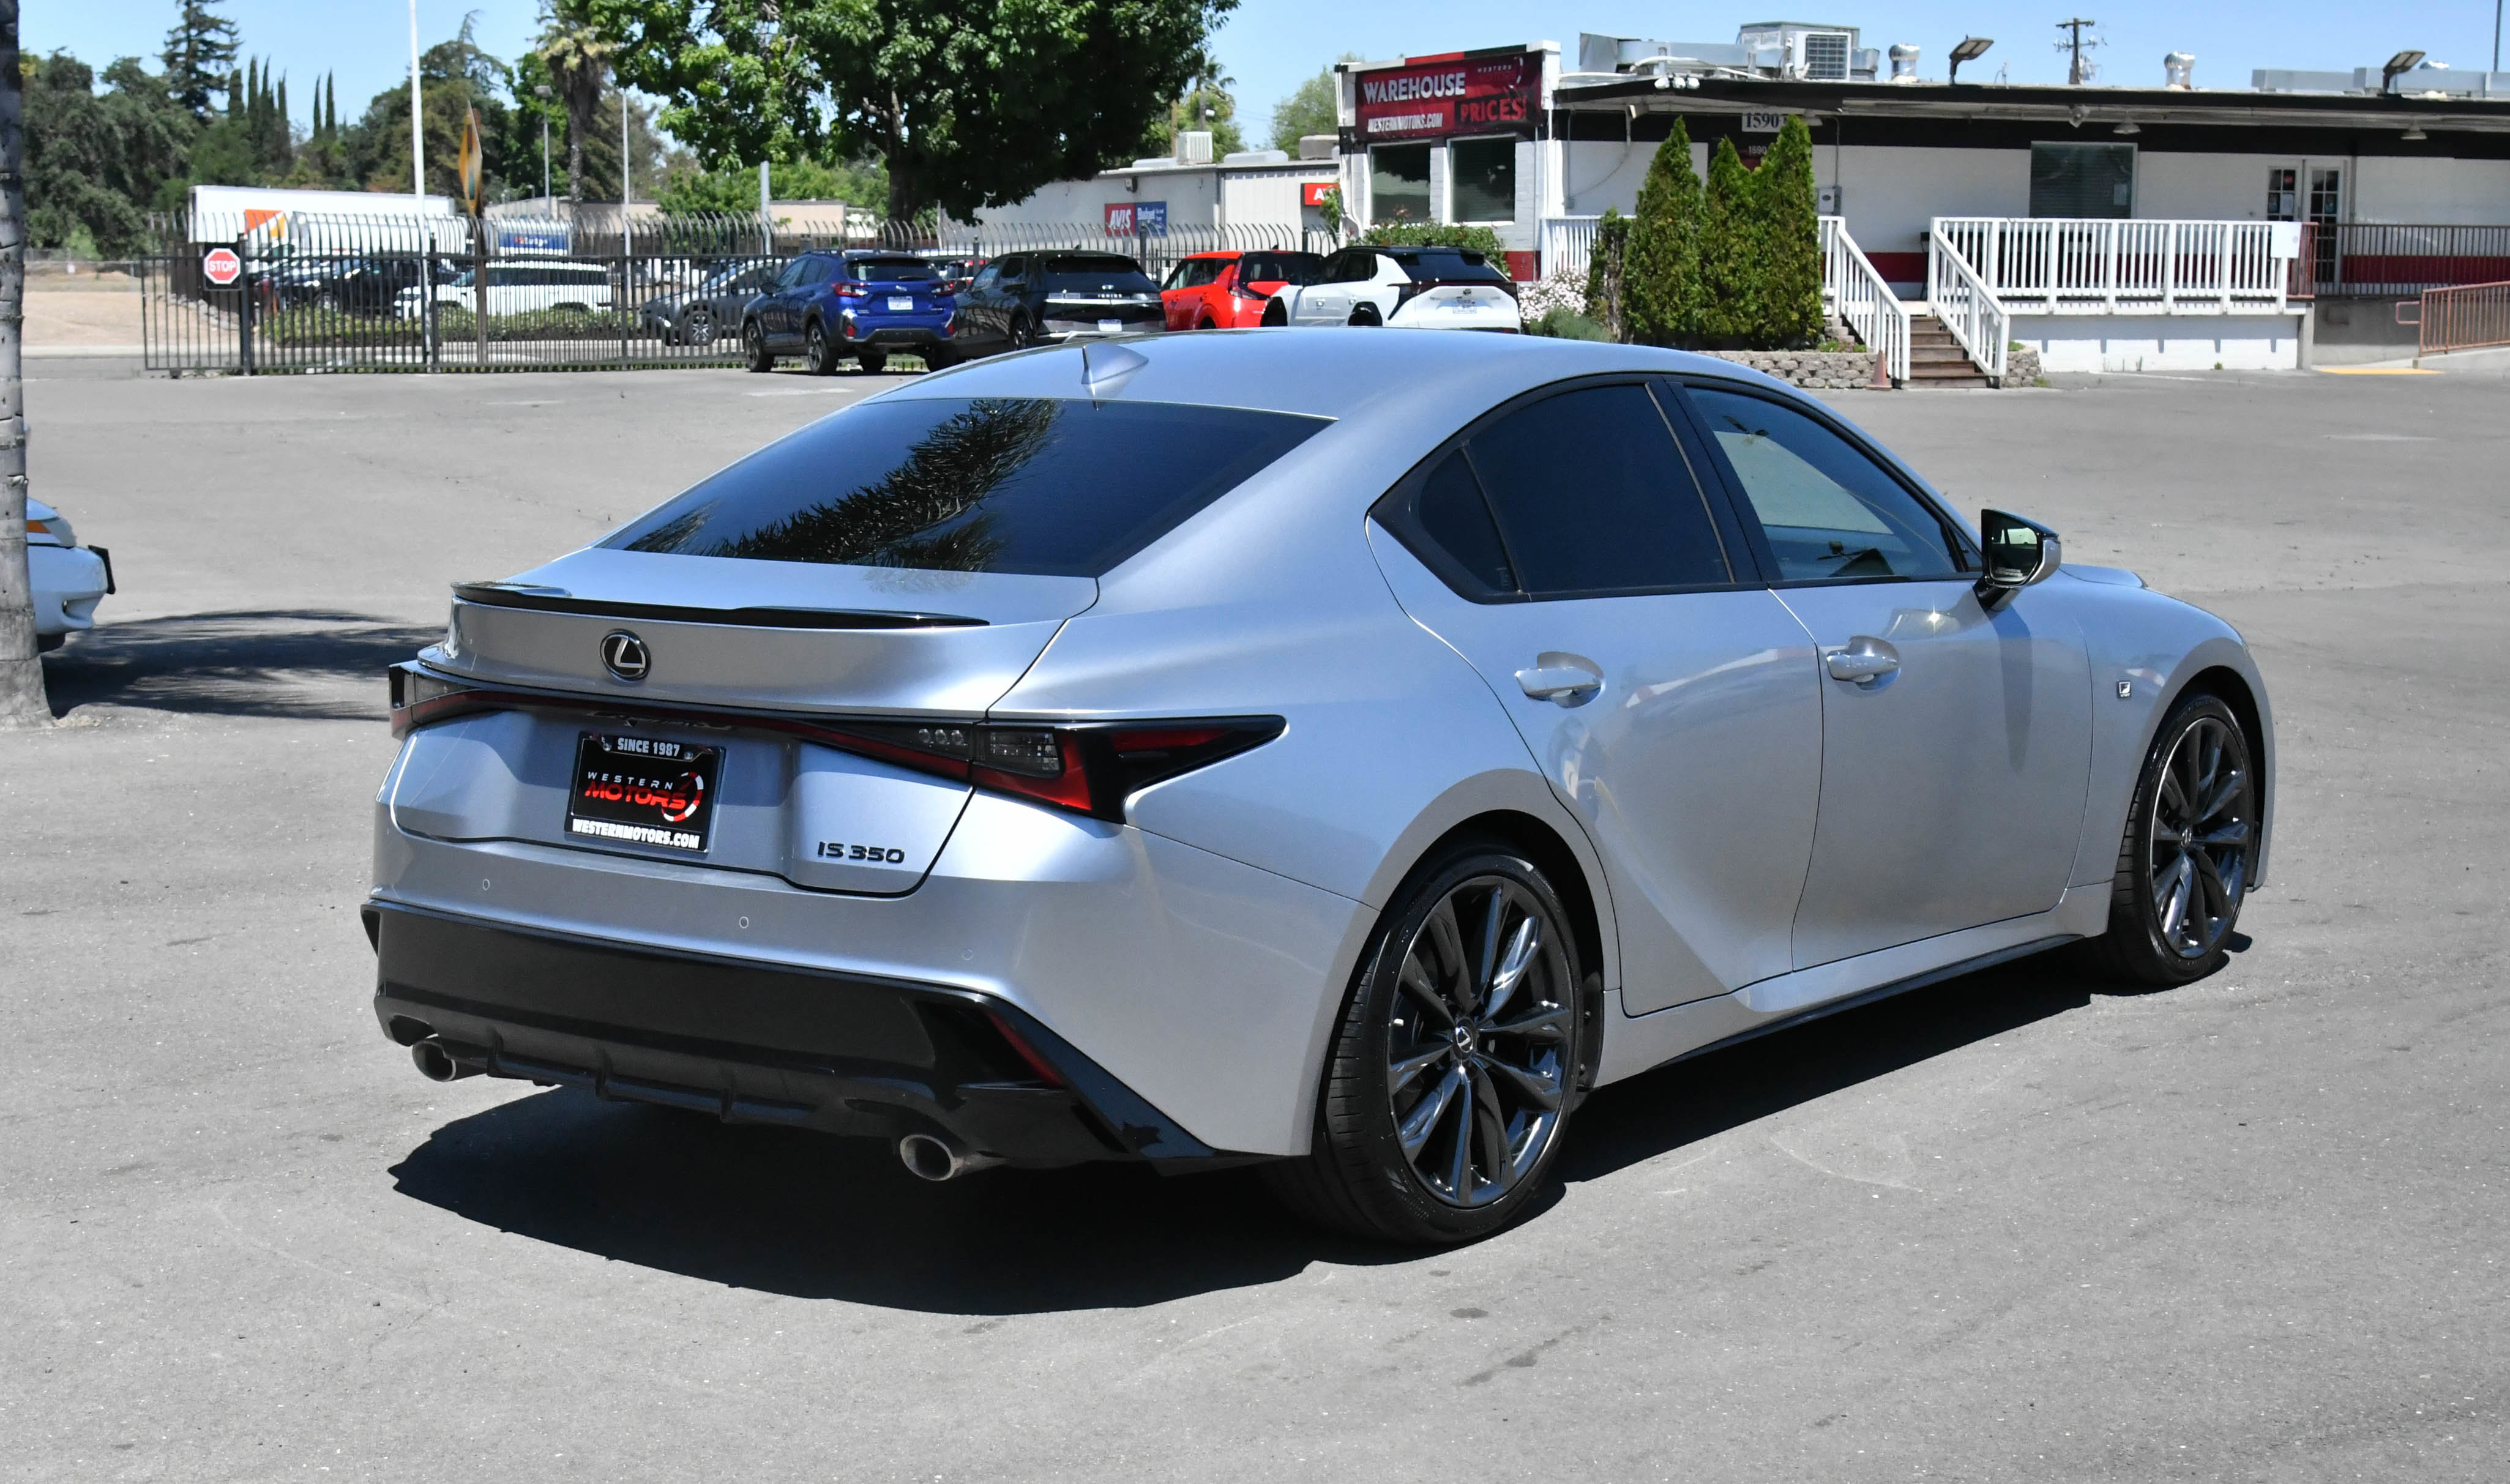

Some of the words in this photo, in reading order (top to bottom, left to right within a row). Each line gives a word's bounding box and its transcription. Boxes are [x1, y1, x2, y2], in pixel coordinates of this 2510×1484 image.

[1363, 72, 1466, 104] WAREHOUSE
[1460, 94, 1528, 122] PRICES!
[1747, 113, 1779, 128] 1590
[1110, 209, 1132, 230] AVIS
[209, 260, 236, 272] STOP
[618, 737, 649, 753] SINCE
[653, 742, 681, 757] 1987
[588, 771, 674, 790] WESTERN
[584, 781, 687, 810] MOTORS
[572, 818, 700, 849] WESTERNMOTORS.COM
[818, 841, 845, 857] IS
[848, 845, 905, 863] 350
